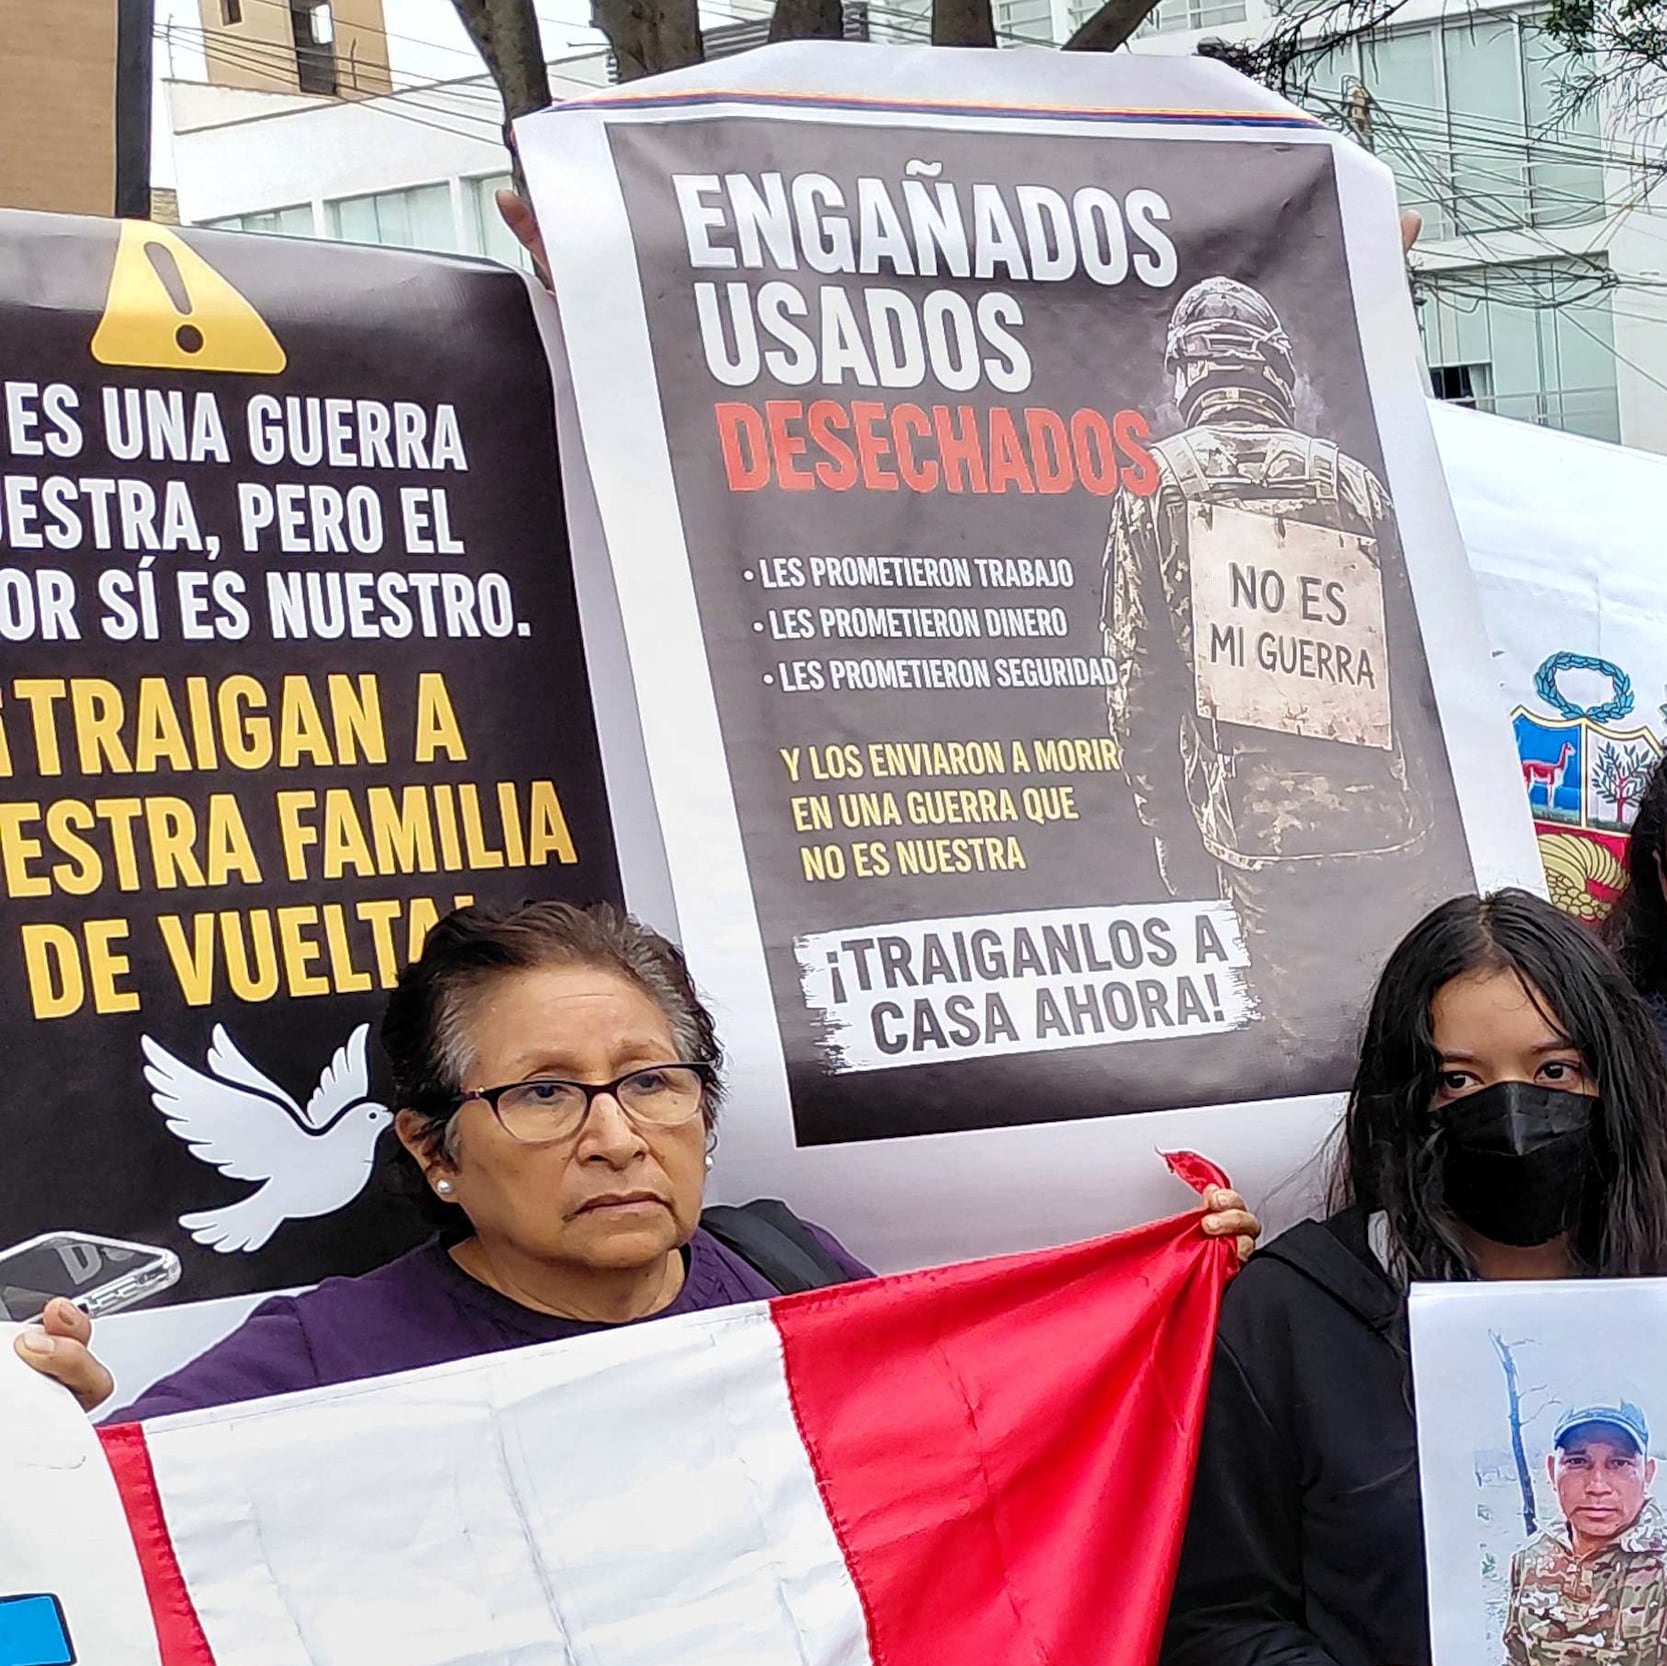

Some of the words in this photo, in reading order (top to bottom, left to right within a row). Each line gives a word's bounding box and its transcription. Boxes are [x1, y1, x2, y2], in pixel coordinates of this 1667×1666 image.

[671, 159, 1179, 288] ENGAÑADOS
[696, 283, 1033, 394] USADOS
[5, 381, 83, 458] ES
[102, 387, 231, 463] UNA
[247, 394, 468, 472] GUERRA
[717, 400, 1161, 497] DESECHADOS
[0, 476, 221, 560] ESTRA,
[237, 482, 385, 554] PERO
[404, 488, 465, 556] EL
[0, 567, 81, 641] OR
[98, 556, 160, 640] SÍ
[176, 570, 250, 640] ES
[266, 571, 532, 642] NUESTRO.
[759, 558, 806, 588] LES
[809, 556, 972, 588] PROMETIERON
[975, 558, 1075, 588] TRABAJO
[1229, 562, 1285, 614] NO
[1299, 576, 1347, 626] ES
[768, 609, 815, 640] LES
[819, 607, 982, 639] PROMETIERON
[984, 608, 1068, 638] DINERO
[1210, 622, 1245, 667] MI
[1257, 631, 1376, 690] GUERRA
[415, 672, 468, 762] A
[778, 661, 825, 692] LES
[829, 659, 991, 690] PROMETIERON
[995, 658, 1119, 688] SEGURIDAD
[779, 748, 800, 782] Y
[809, 745, 863, 780] LOS
[868, 742, 1005, 778] ENVIARON
[1012, 740, 1031, 773] A
[1033, 738, 1121, 773] MORIR
[0, 794, 263, 898] ESTRA
[276, 780, 579, 880] FAMILIA
[791, 795, 833, 832] EN
[838, 791, 902, 829] UNA
[907, 789, 1018, 825] GUERRA
[1022, 786, 1080, 824] QUE
[800, 845, 846, 881] NO
[852, 842, 890, 878] ES
[895, 836, 1027, 876] NUESTRA
[21, 918, 141, 1020] DE
[158, 895, 475, 1007] VUELTA
[825, 916, 1178, 1005] ¡TRAIGANLOS
[1195, 914, 1228, 964] A
[870, 991, 1020, 1055] CASA
[1035, 973, 1227, 1039] AHORA!
